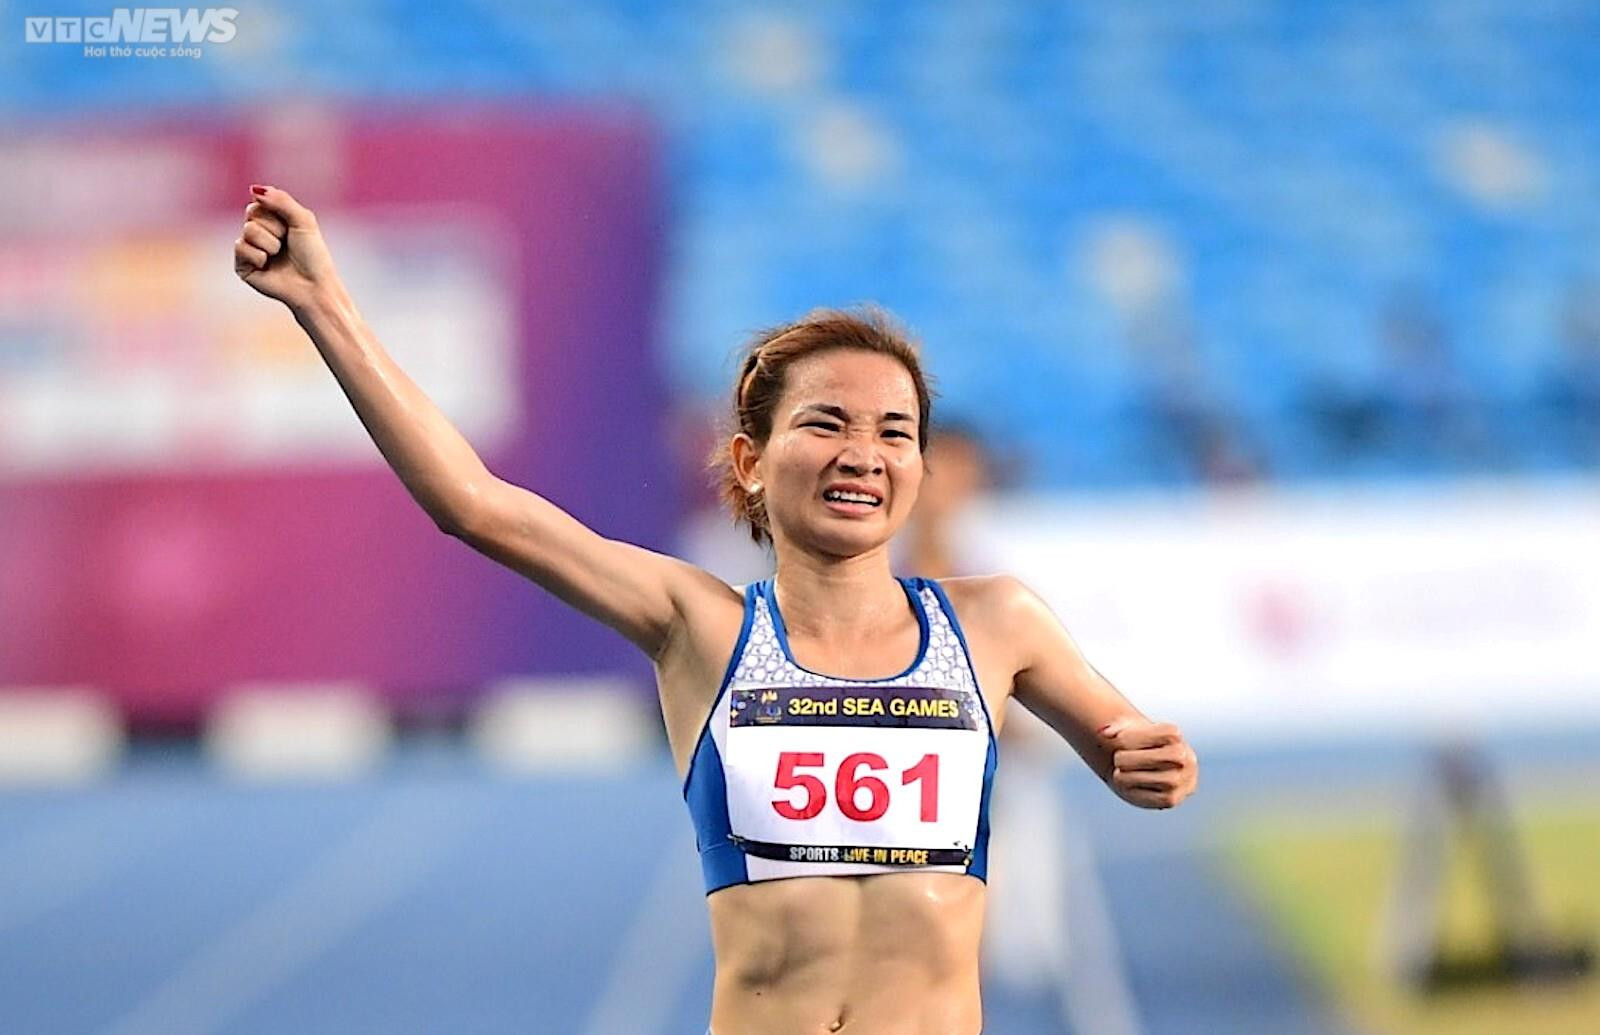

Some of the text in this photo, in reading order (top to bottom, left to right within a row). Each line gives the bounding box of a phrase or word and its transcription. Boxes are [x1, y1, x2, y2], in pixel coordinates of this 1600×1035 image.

[788, 698, 960, 718] 32nd SEA GAMES
[771, 752, 940, 823] 561
[789, 846, 839, 861] SPORTS
[873, 848, 888, 863] IN
[890, 849, 929, 864] PEACE
